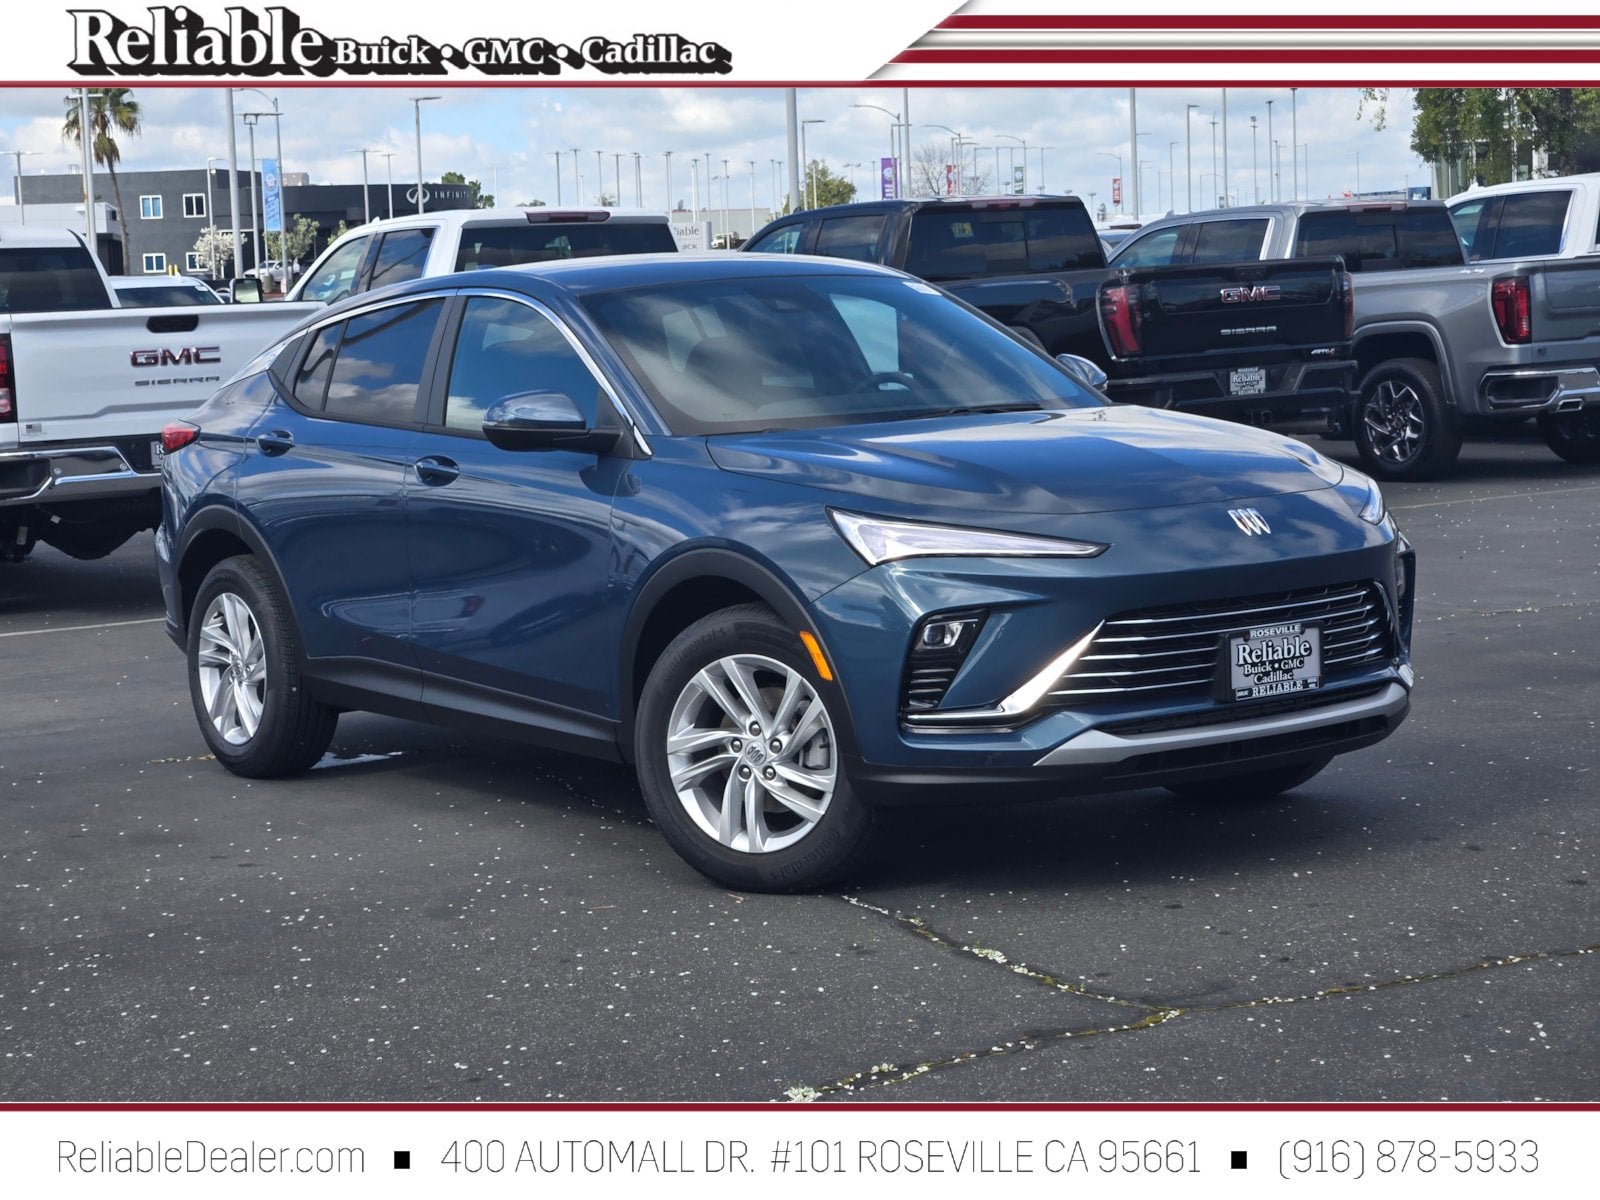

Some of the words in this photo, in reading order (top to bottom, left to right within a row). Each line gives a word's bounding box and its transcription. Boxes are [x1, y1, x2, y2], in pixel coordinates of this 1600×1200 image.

[434, 190, 470, 200] INFINITI
[1220, 285, 1281, 304] GMC
[1220, 325, 1277, 336] SIERRA
[130, 345, 222, 369] GMC
[134, 375, 220, 387] SIERRA
[1250, 624, 1301, 639] ROSEVILLE
[1236, 636, 1312, 667] Reliable
[1243, 661, 1273, 676] Buick
[1280, 657, 1305, 670] GMC
[1254, 670, 1294, 685] Cadillac
[1251, 680, 1304, 697] RELIABLE
